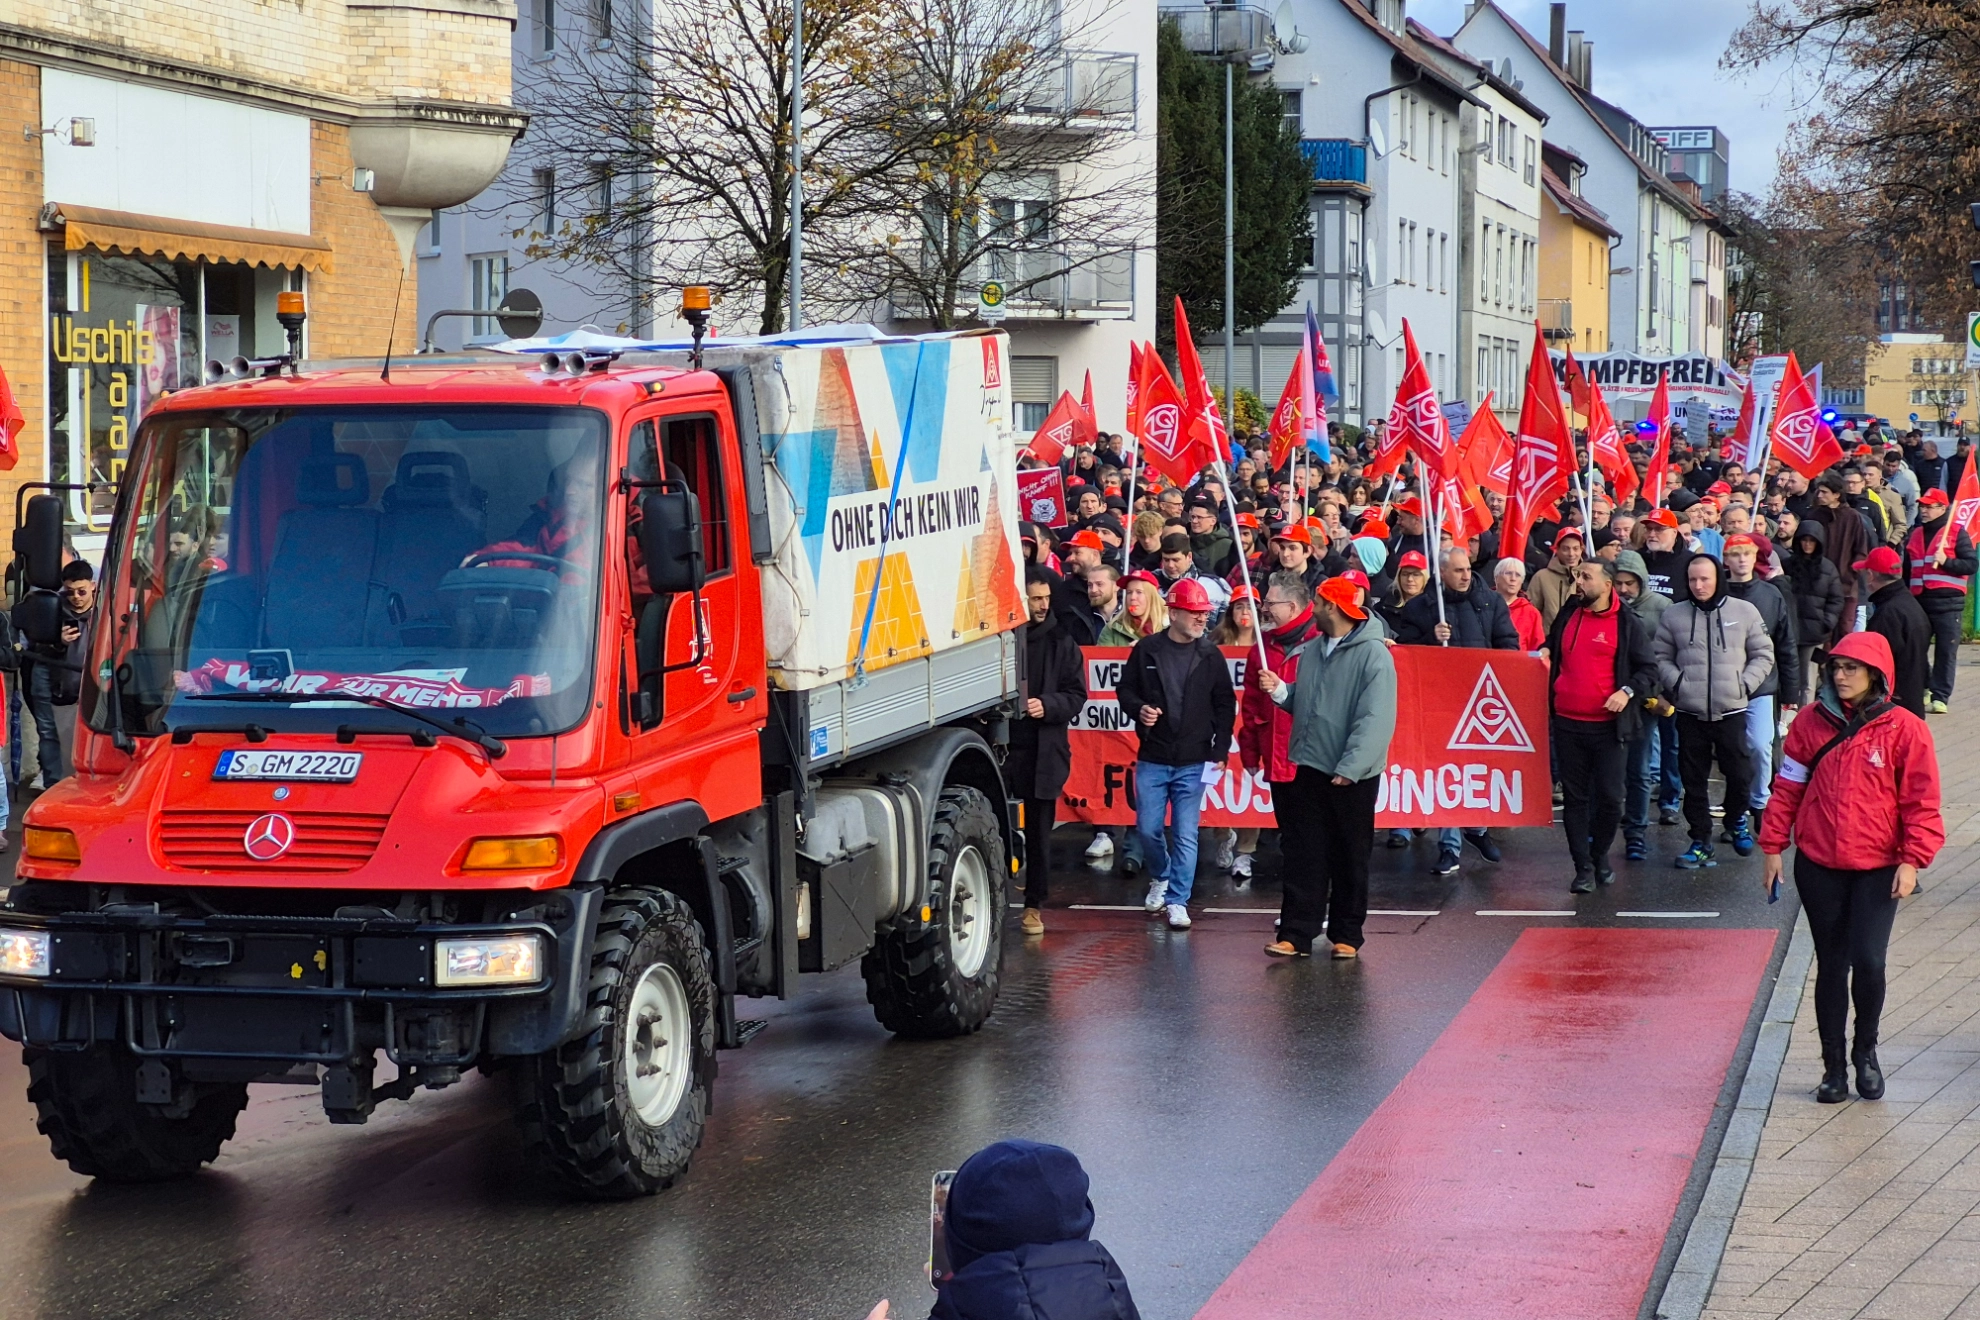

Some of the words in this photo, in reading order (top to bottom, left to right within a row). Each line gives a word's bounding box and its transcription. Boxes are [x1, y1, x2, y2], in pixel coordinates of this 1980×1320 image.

[53, 316, 154, 364] Uschi's
[1018, 481, 1039, 495] NICHT
[1025, 483, 1048, 500] KAMPF
[831, 503, 876, 553] OHNE
[878, 496, 914, 544] DICH
[917, 490, 952, 536] KEIN
[954, 485, 981, 528] WIR
[299, 755, 356, 776] 2220
